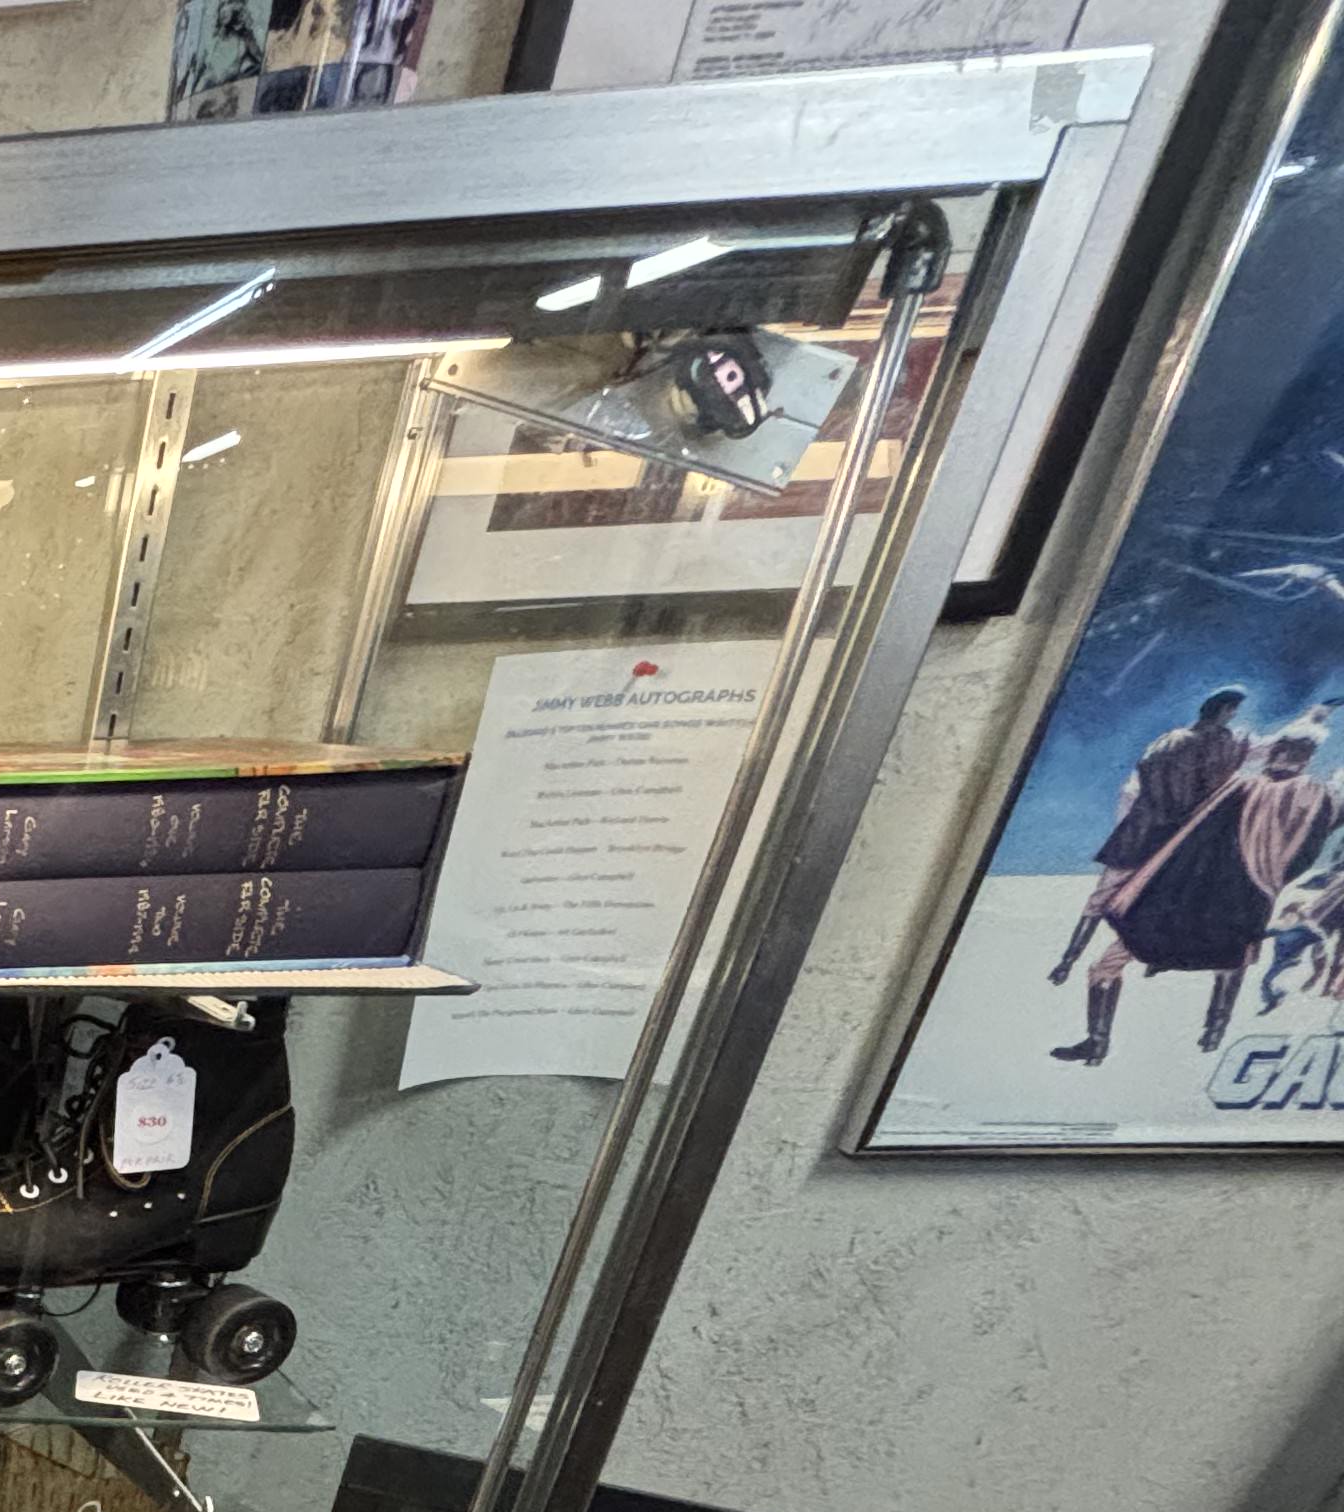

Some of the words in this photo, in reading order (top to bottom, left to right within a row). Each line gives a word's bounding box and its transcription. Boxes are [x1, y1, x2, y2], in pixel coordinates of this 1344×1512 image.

[579, 693, 625, 709] WEBB
[625, 688, 757, 707] AUTOGRAPHS
[93, 1391, 146, 1405] LIKE
